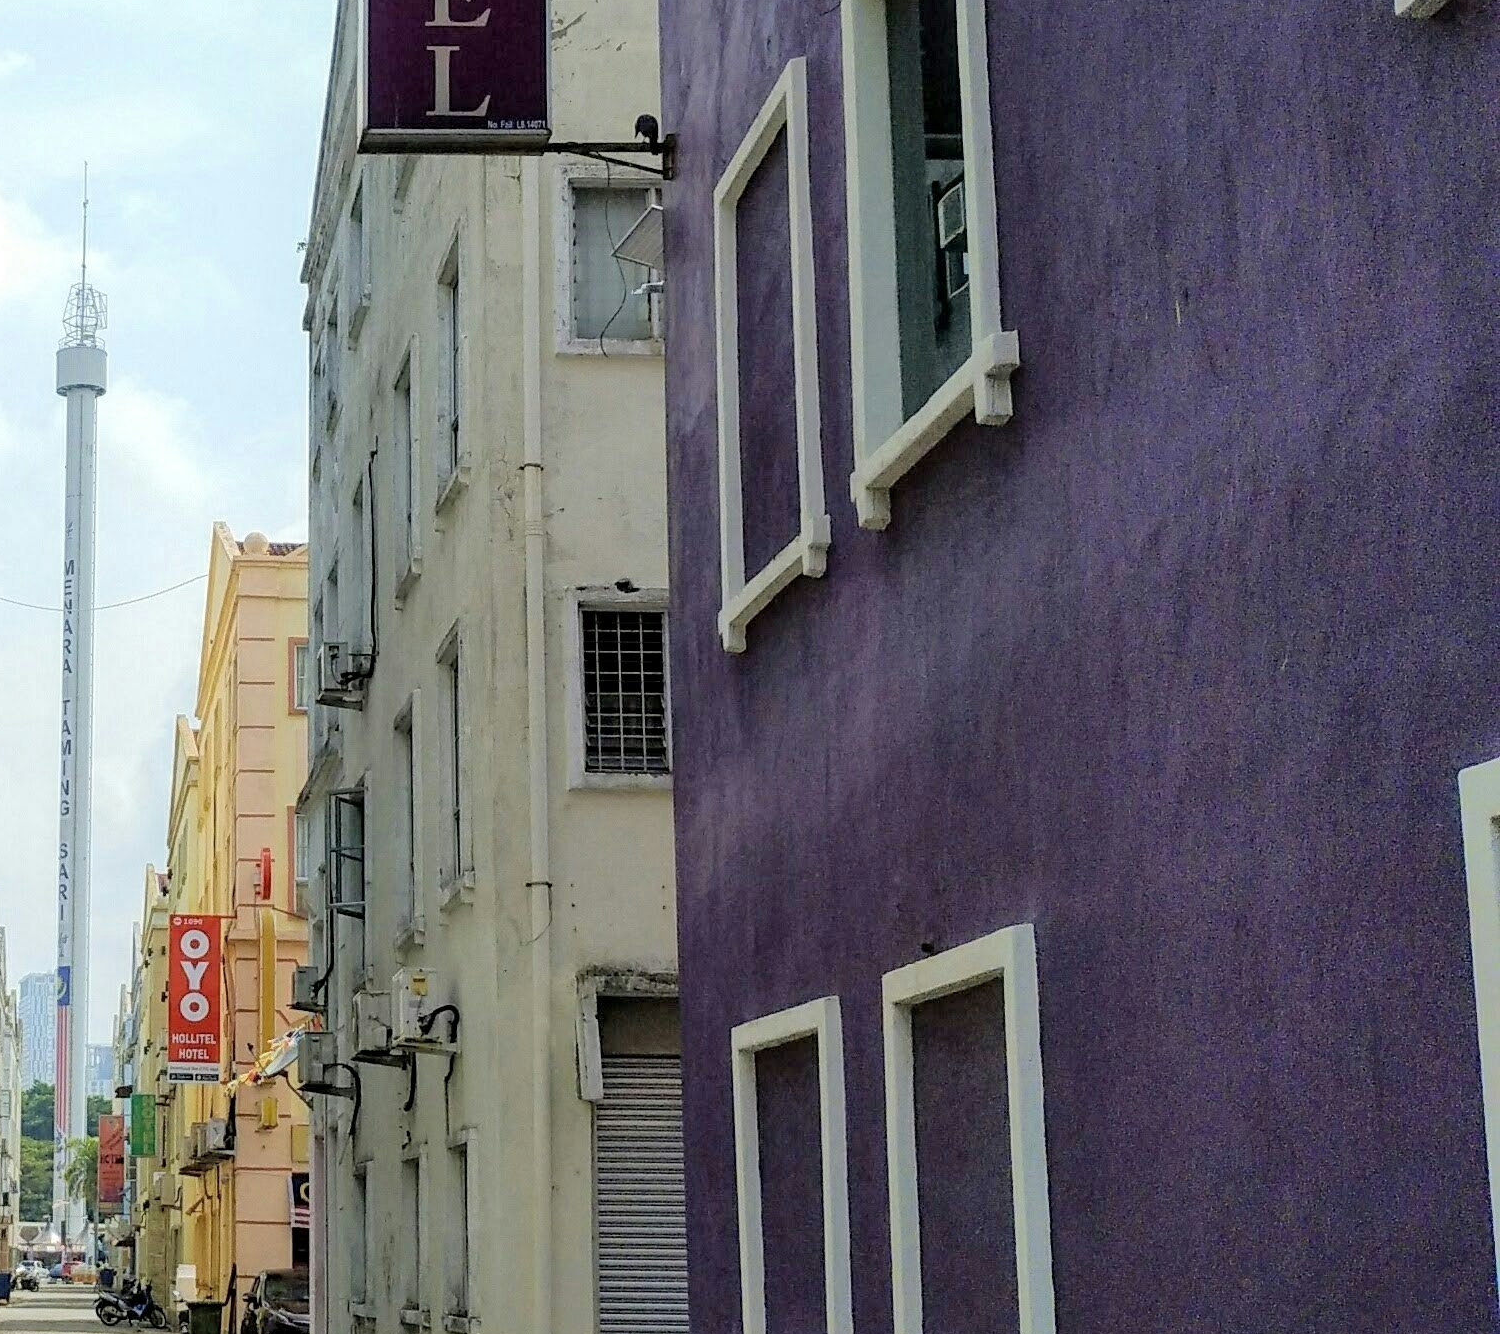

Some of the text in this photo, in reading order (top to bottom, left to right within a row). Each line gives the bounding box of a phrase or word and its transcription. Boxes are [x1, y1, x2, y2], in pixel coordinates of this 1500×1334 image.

[59, 842, 69, 921] SARI
[180, 929, 210, 1022] OYO
[171, 1033, 217, 1045] HOLLITEL
[178, 1048, 210, 1060] HOTEL
